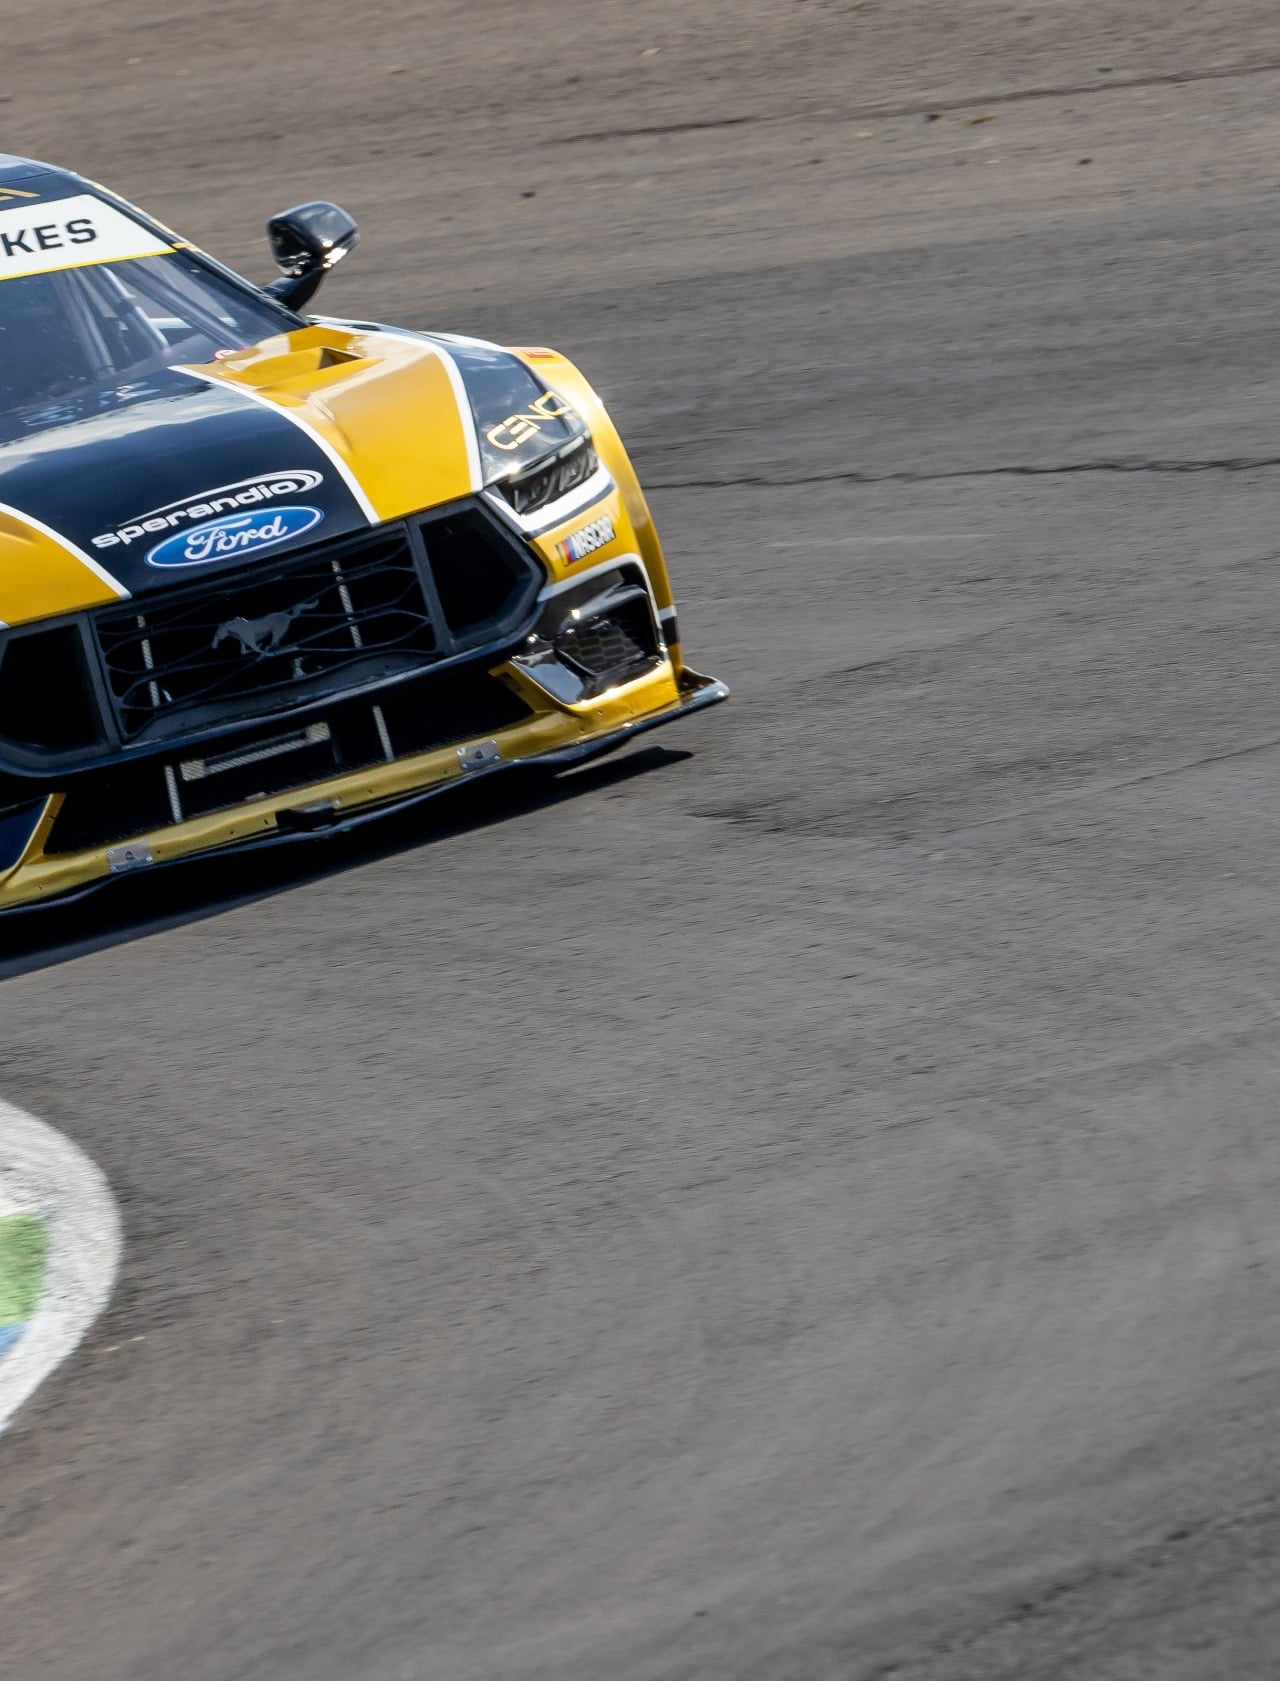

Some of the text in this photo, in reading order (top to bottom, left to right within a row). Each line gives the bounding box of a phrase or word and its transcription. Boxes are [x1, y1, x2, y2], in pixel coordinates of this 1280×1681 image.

[90, 478, 299, 550] sperandio
[570, 514, 616, 560] NASCAR
[183, 515, 289, 561] Ford
